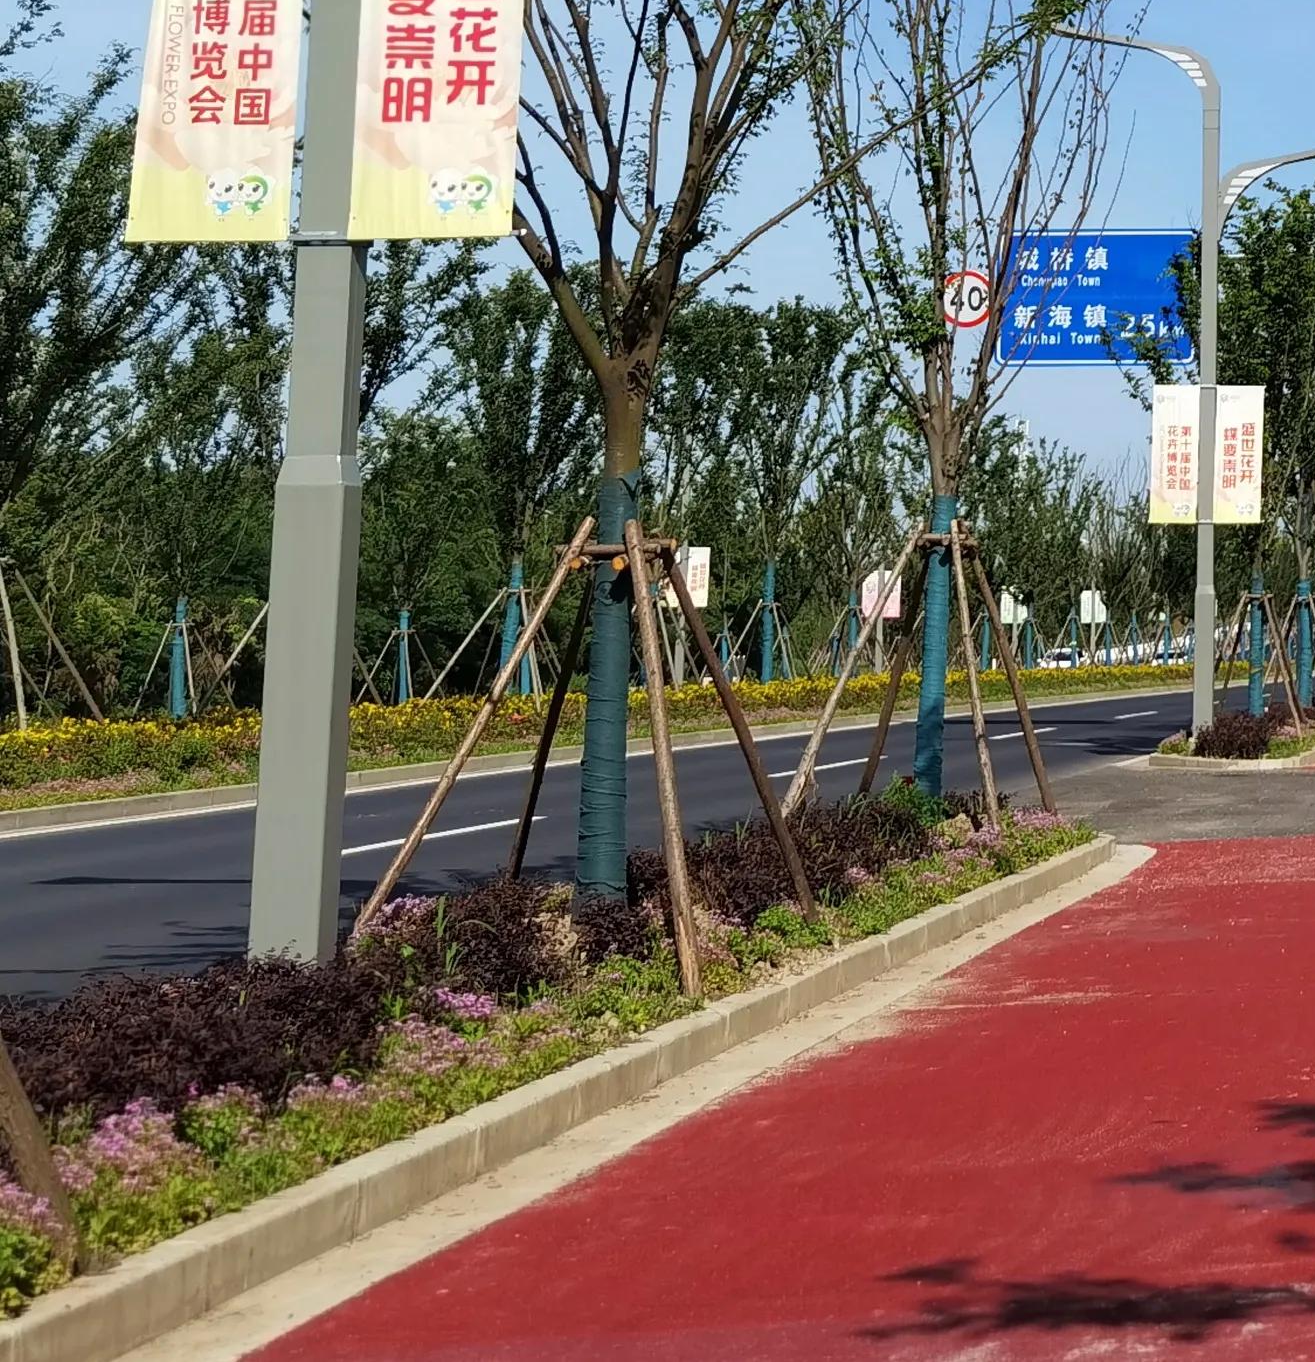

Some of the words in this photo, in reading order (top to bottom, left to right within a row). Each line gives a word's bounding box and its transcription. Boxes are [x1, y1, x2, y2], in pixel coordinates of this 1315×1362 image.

[165, 4, 184, 74] FLOWER
[161, 79, 179, 125] EXPO
[1077, 274, 1101, 287] Town
[950, 286, 983, 312] 40
[1014, 304, 1107, 328] 新海镇
[1070, 332, 1101, 345] Town
